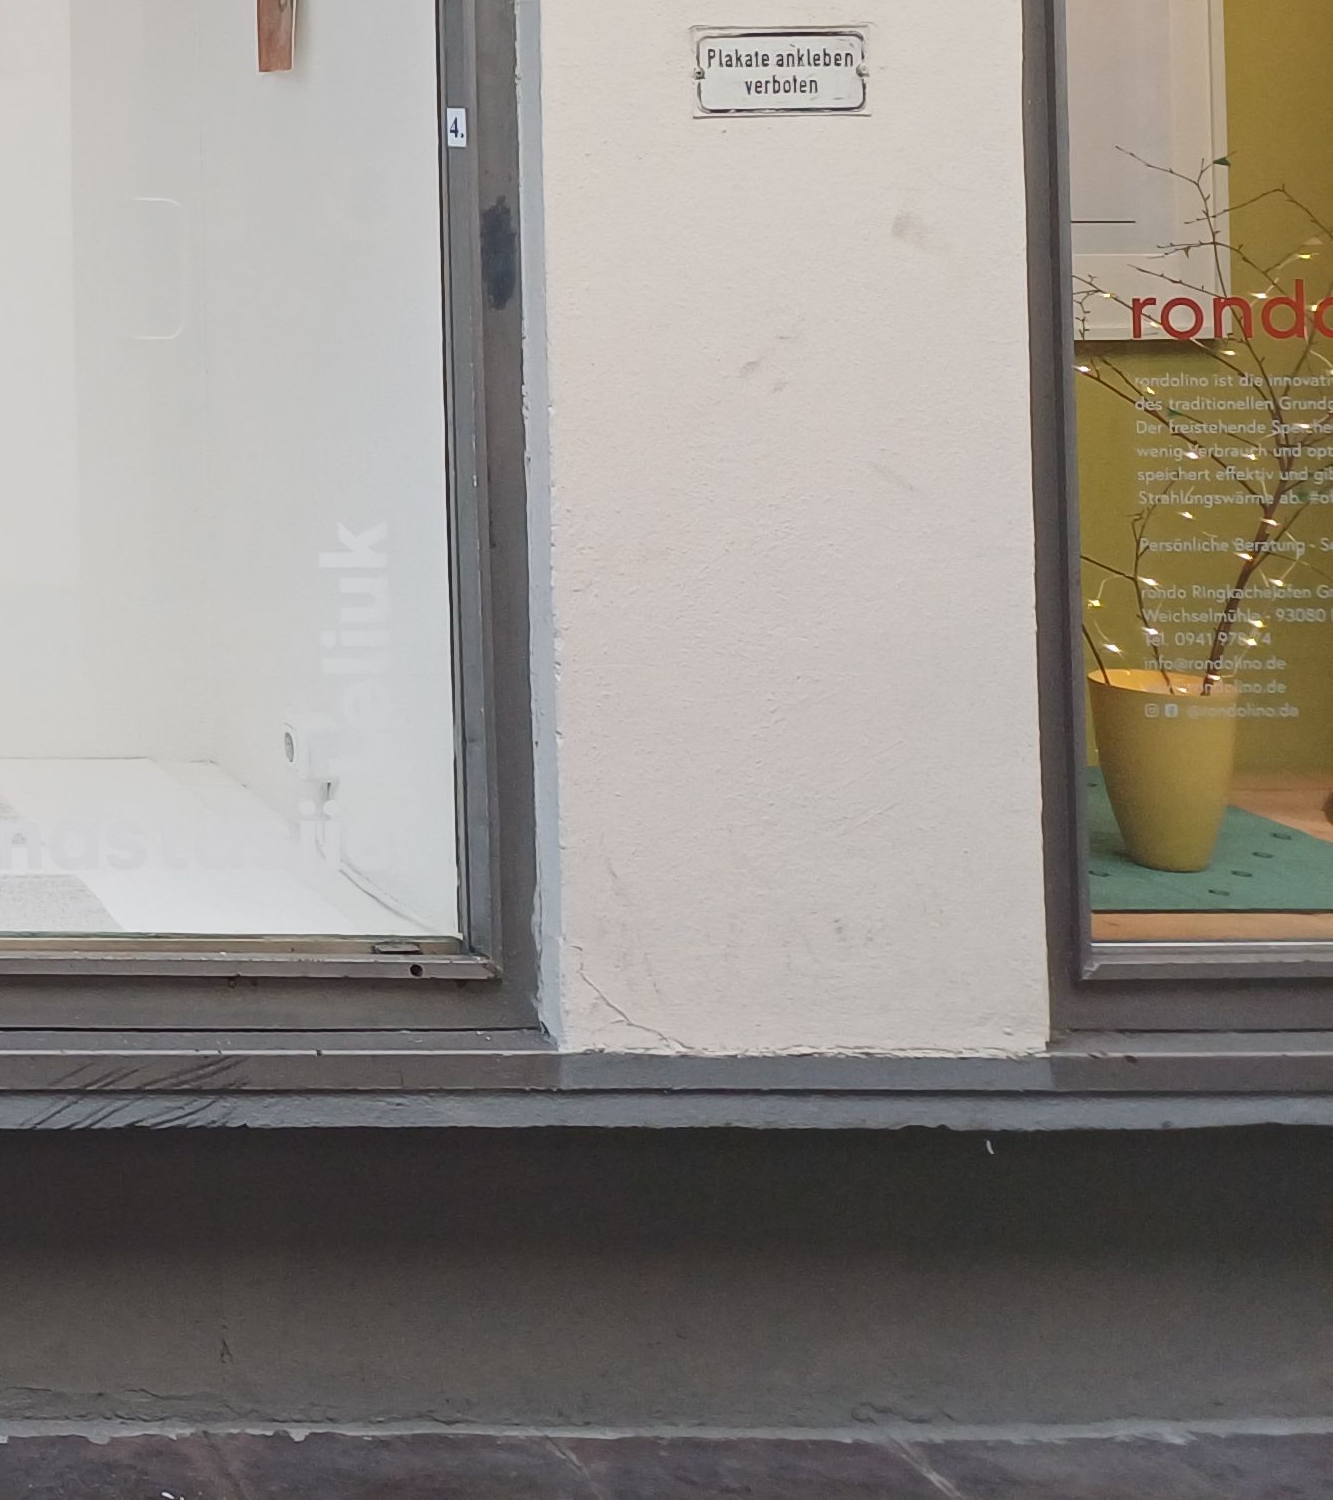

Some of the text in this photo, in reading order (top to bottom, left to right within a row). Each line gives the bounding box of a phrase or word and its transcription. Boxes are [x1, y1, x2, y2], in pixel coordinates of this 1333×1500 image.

[707, 47, 855, 69] Plakate ankleben
[744, 76, 819, 96] verboten
[1135, 372, 1209, 388] rondolino
[1213, 373, 1233, 388] ist
[1238, 372, 1264, 388] die
[1135, 397, 1163, 411] des
[1169, 397, 1275, 411] traditionellen
[1136, 419, 1333, 437] Der freistehende Speihe
[1137, 447, 1182, 461] wenig
[1188, 443, 1264, 458] Verbrauch
[1273, 443, 1302, 457] und
[1138, 467, 1211, 484] speichert
[1216, 465, 1274, 481] effektiv
[1279, 467, 1309, 481] und
[1138, 490, 1274, 508] Strahlungswärme
[1140, 538, 1229, 552] Persönliche
[1235, 537, 1306, 556] Beratung
[1141, 585, 1187, 599] rondo
[1142, 608, 1261, 623] Weichselmühle
[1175, 632, 1213, 646] 0941
